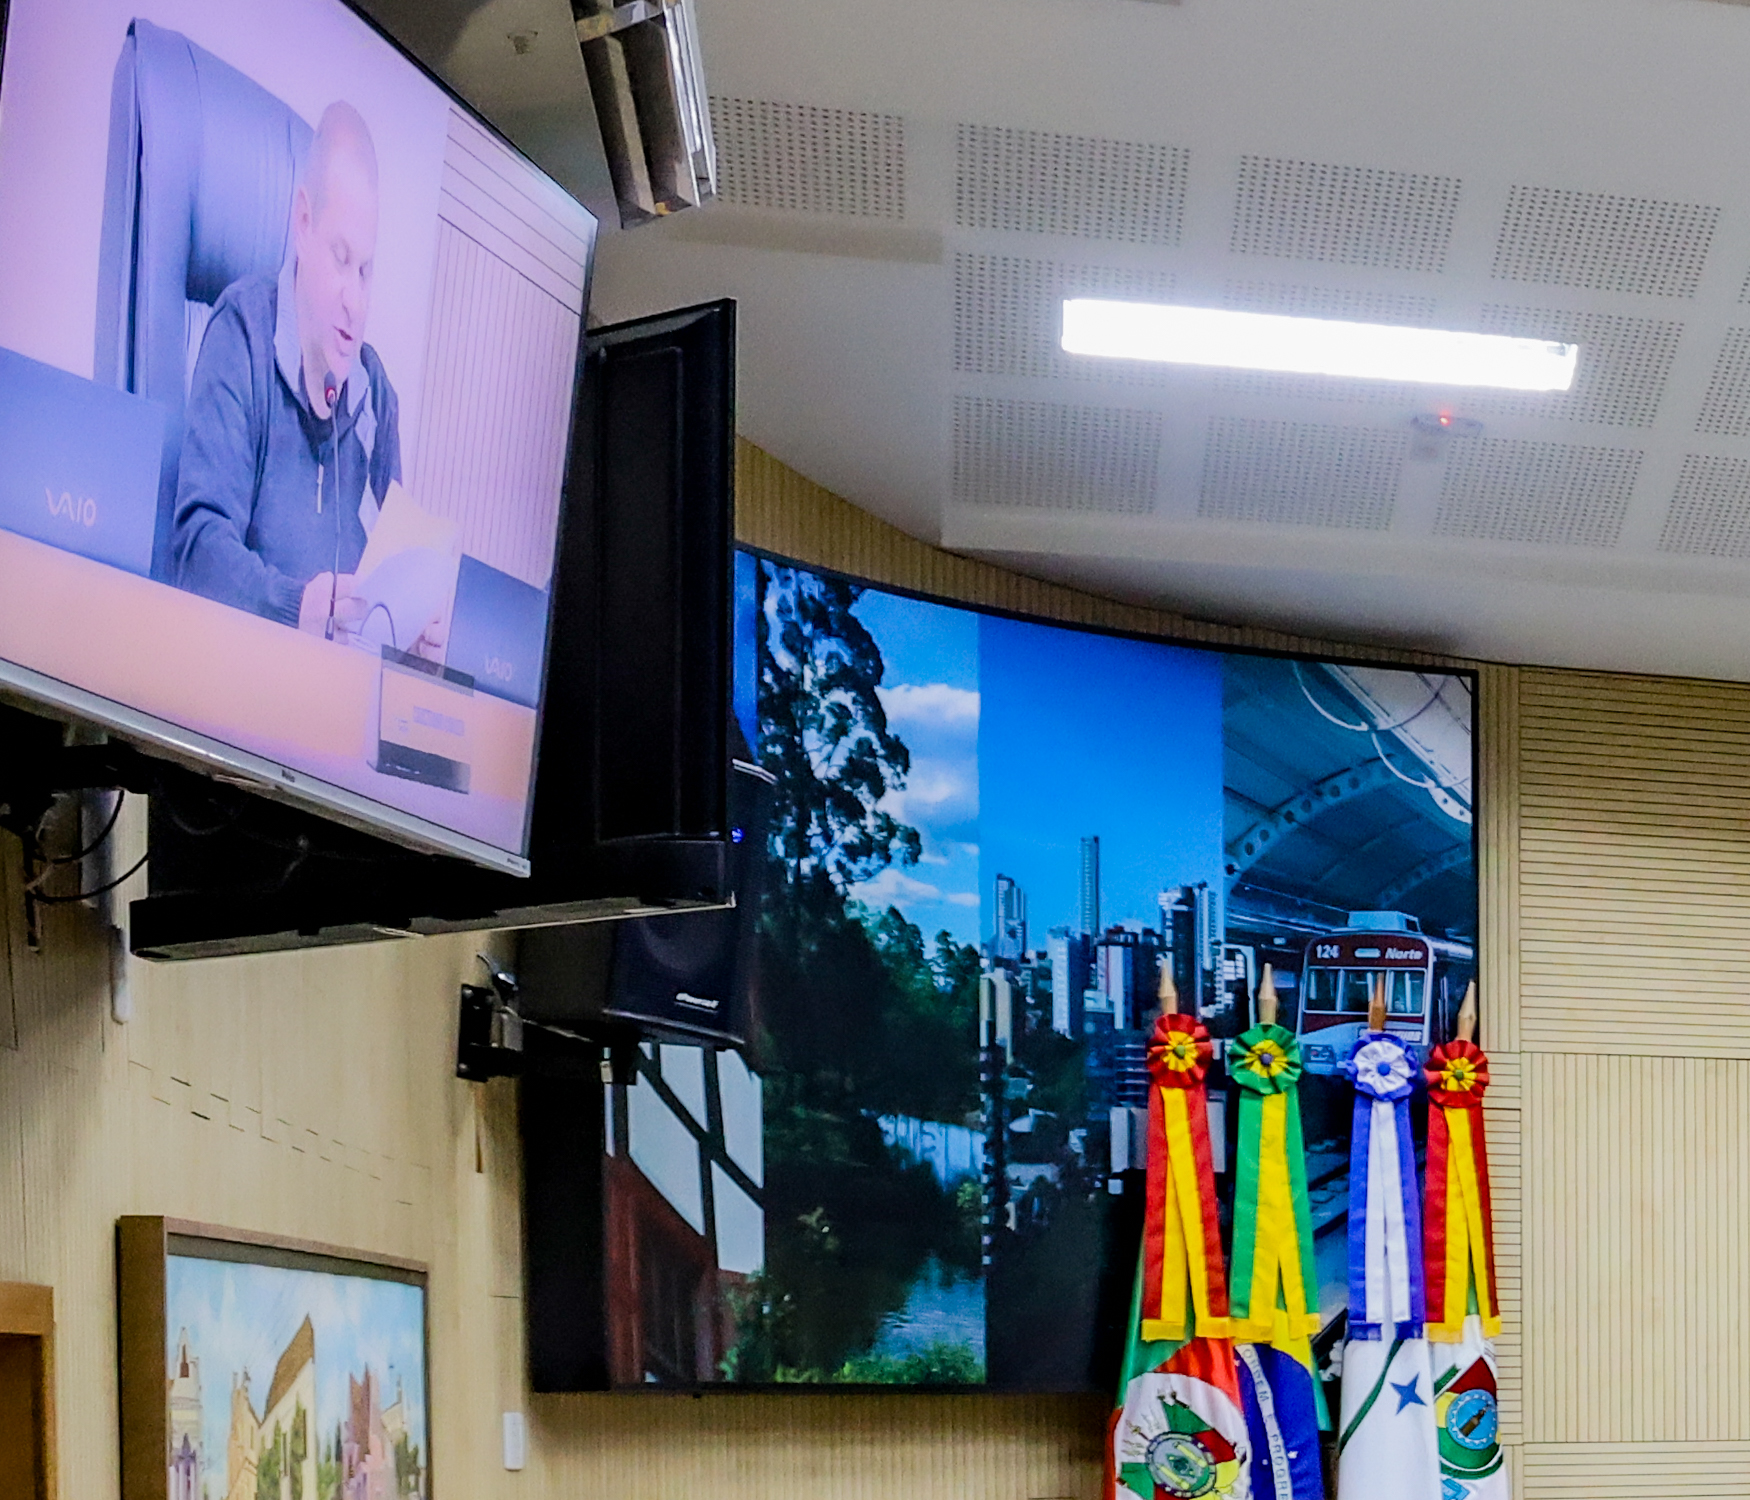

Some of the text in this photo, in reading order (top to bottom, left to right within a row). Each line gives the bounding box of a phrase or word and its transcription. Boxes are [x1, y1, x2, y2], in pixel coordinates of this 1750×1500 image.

[45, 487, 97, 528] VAIO
[1316, 944, 1424, 960] 124 Norte
